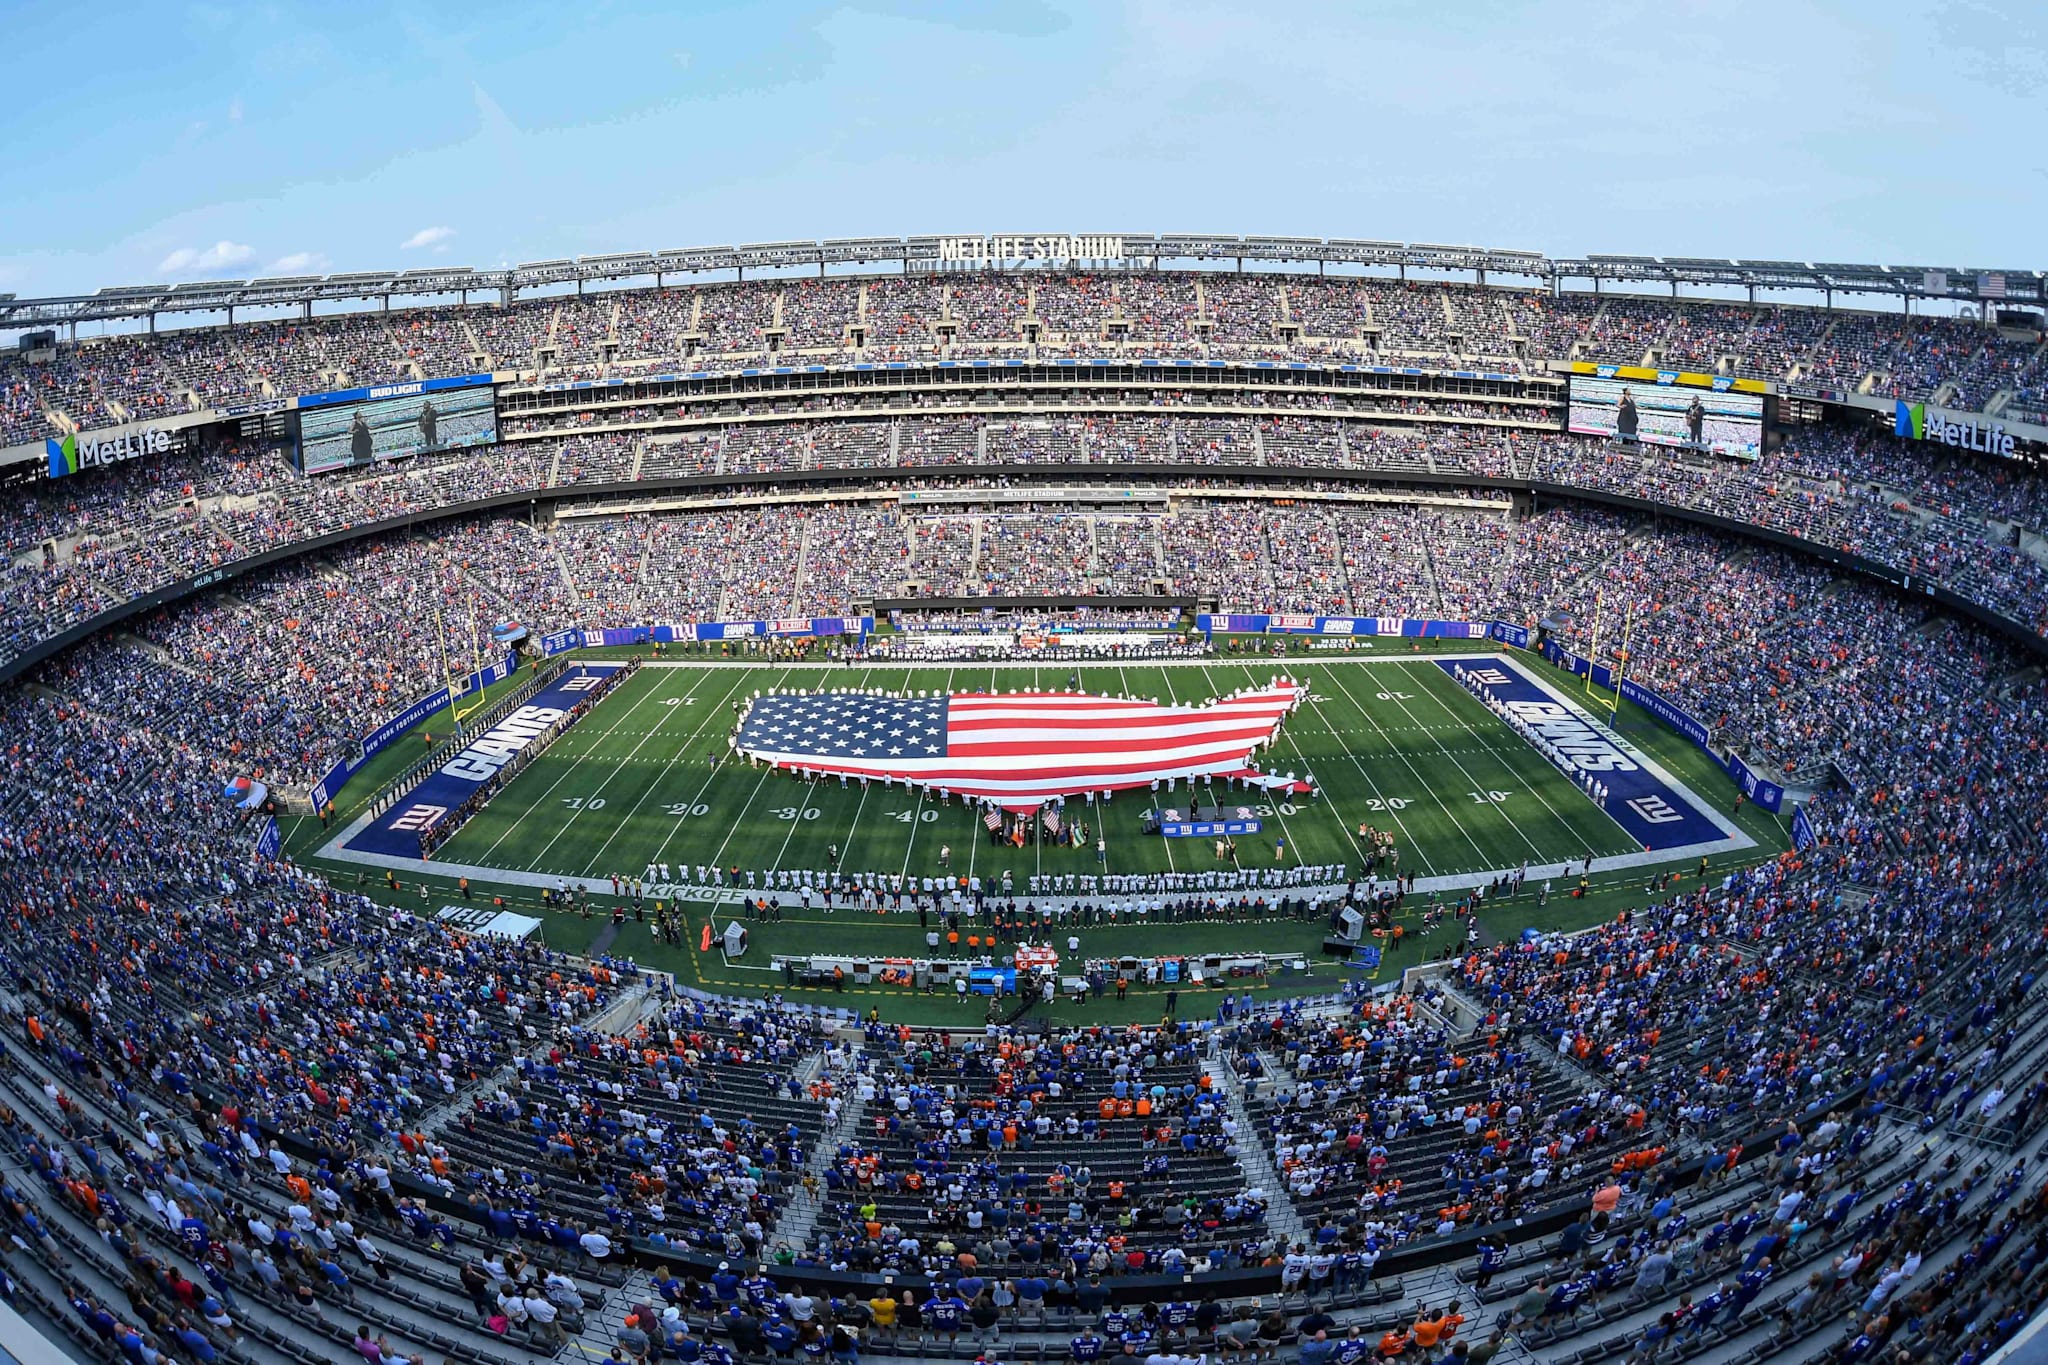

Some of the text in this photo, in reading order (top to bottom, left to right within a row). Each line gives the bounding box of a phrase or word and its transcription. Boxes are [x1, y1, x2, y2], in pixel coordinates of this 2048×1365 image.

[939, 237, 1123, 263] METLIFE STADIUM
[1597, 366, 1615, 377] SAP
[1657, 372, 1675, 384] SAP
[370, 382, 423, 399] BUD LIGHT
[1712, 378, 1731, 390] SAP
[1926, 412, 2014, 458] MetLife
[80, 426, 169, 470] MetLife
[193, 574, 213, 588] etLife
[723, 624, 755, 637] GIANTS
[843, 618, 861, 633] ny
[1211, 616, 1229, 630] ny
[1323, 620, 1354, 631] GIANTS
[1376, 618, 1403, 636] ny
[1468, 623, 1486, 638] ny
[584, 631, 604, 646] ny
[671, 624, 697, 641] ny
[492, 662, 508, 681] ny
[1469, 668, 1512, 684] ny
[560, 676, 602, 691] ny
[1622, 684, 1705, 743] NEW YORK FOOTBALL GIANTS
[366, 694, 449, 753] NEW YORK FOOTBALL GIANTS
[1572, 708, 1637, 752] END RACISM
[441, 705, 564, 781] GIANTS
[1506, 700, 1638, 771] GIANTS
[1745, 772, 1757, 798] ny
[314, 783, 328, 808] ny
[1467, 790, 1507, 804] 10
[565, 797, 605, 810] 10
[666, 803, 709, 816] 20
[1256, 804, 1297, 817] 30
[1366, 797, 1407, 811] 20
[1626, 793, 1684, 824] ny
[388, 804, 447, 831] ny
[778, 807, 821, 820] 30
[895, 808, 939, 823] 40
[650, 886, 744, 902] KICKOFF
[437, 905, 497, 923] WELC
[400, 1214, 415, 1227] 10
[184, 1226, 201, 1242] 56
[1288, 1265, 1301, 1273] 21
[936, 1309, 955, 1319] 64
[1106, 1323, 1122, 1333] 26
